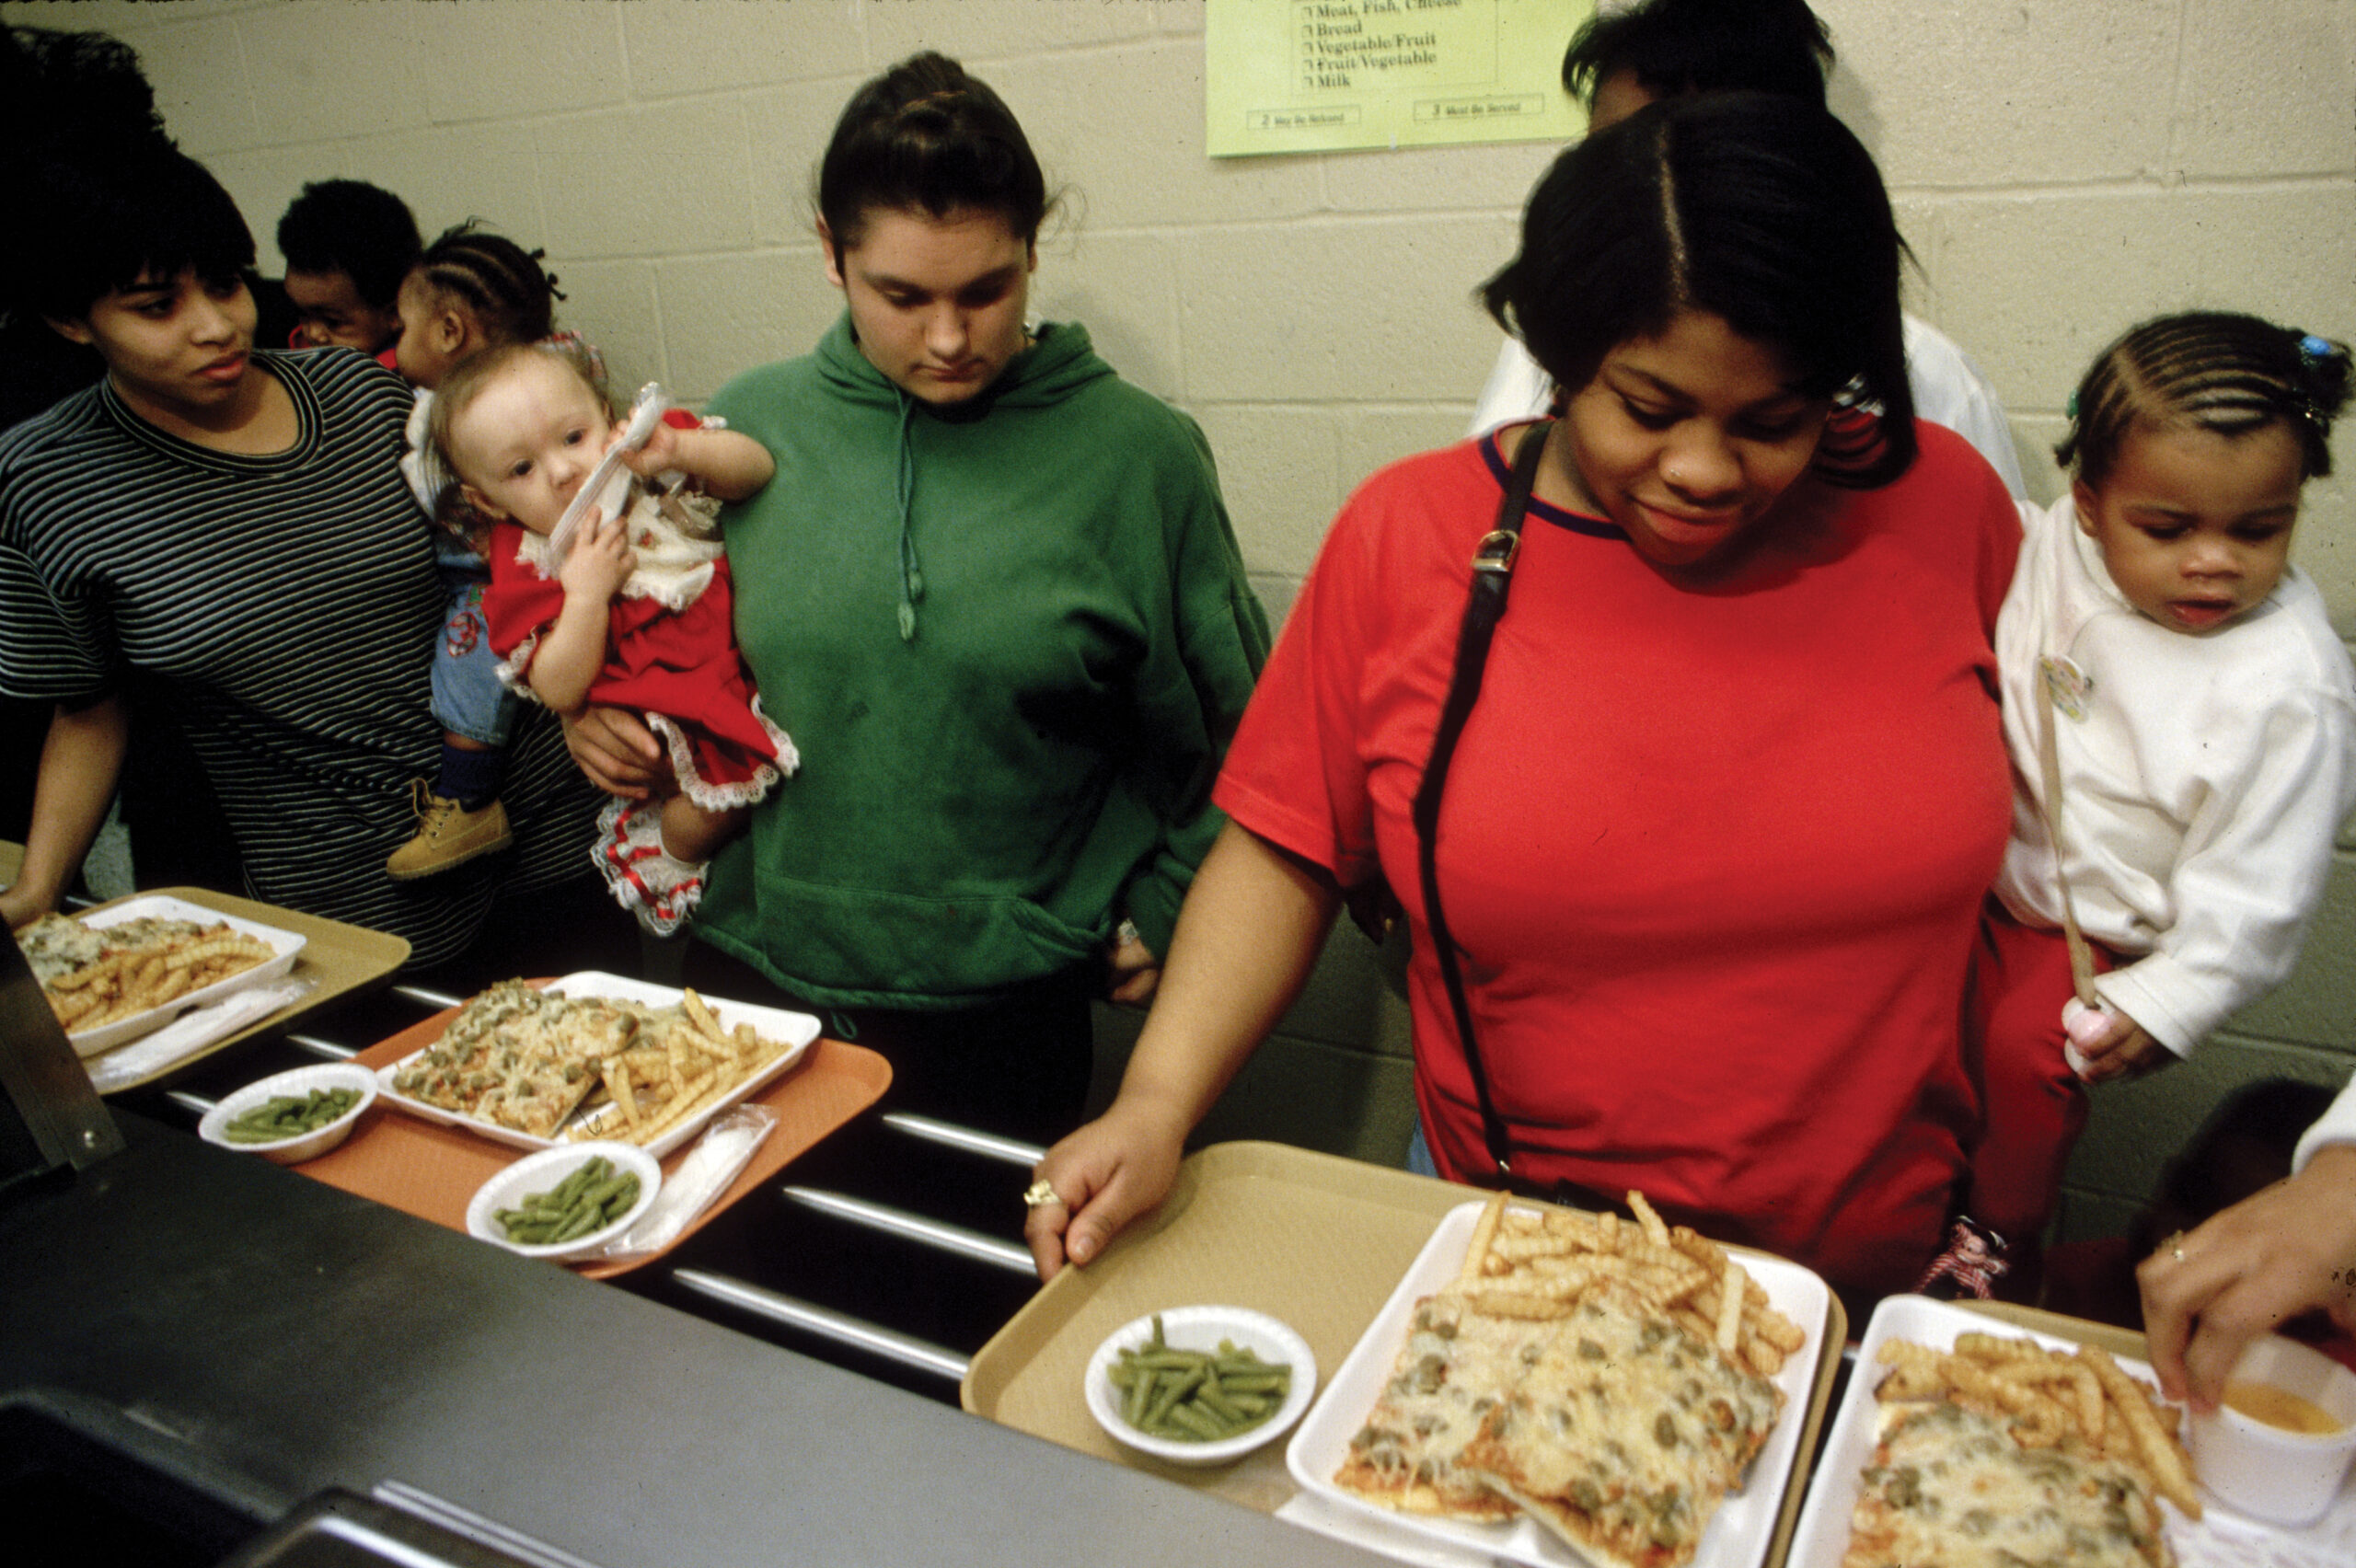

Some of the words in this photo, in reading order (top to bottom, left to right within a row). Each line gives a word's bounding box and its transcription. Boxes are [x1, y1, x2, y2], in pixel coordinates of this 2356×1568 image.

[1317, 5, 1357, 17] Meat,
[1363, 0, 1400, 15] Fish,
[1317, 20, 1362, 37] Bread
[1317, 74, 1350, 87] Milk
